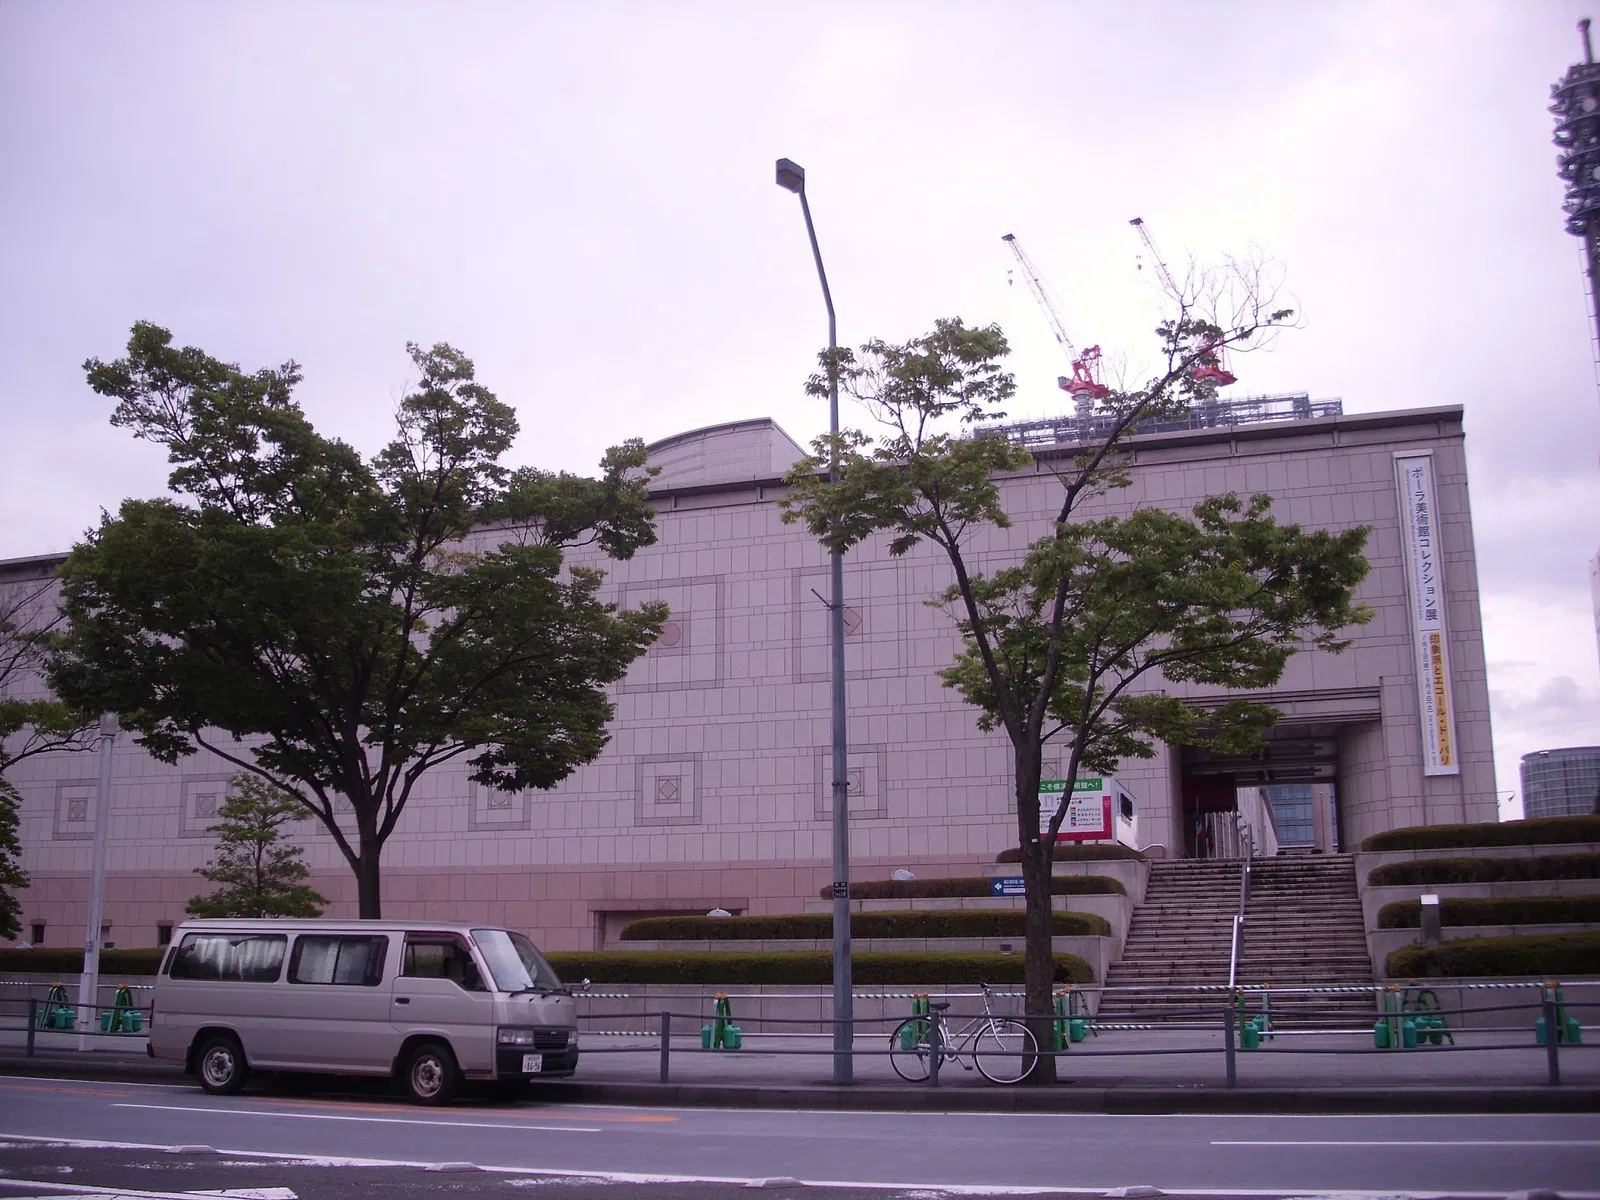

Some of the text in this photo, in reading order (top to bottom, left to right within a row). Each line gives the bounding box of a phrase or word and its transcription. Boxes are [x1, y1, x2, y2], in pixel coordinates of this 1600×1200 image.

[1412, 467, 1437, 620] ポーラ美術館コレクション展
